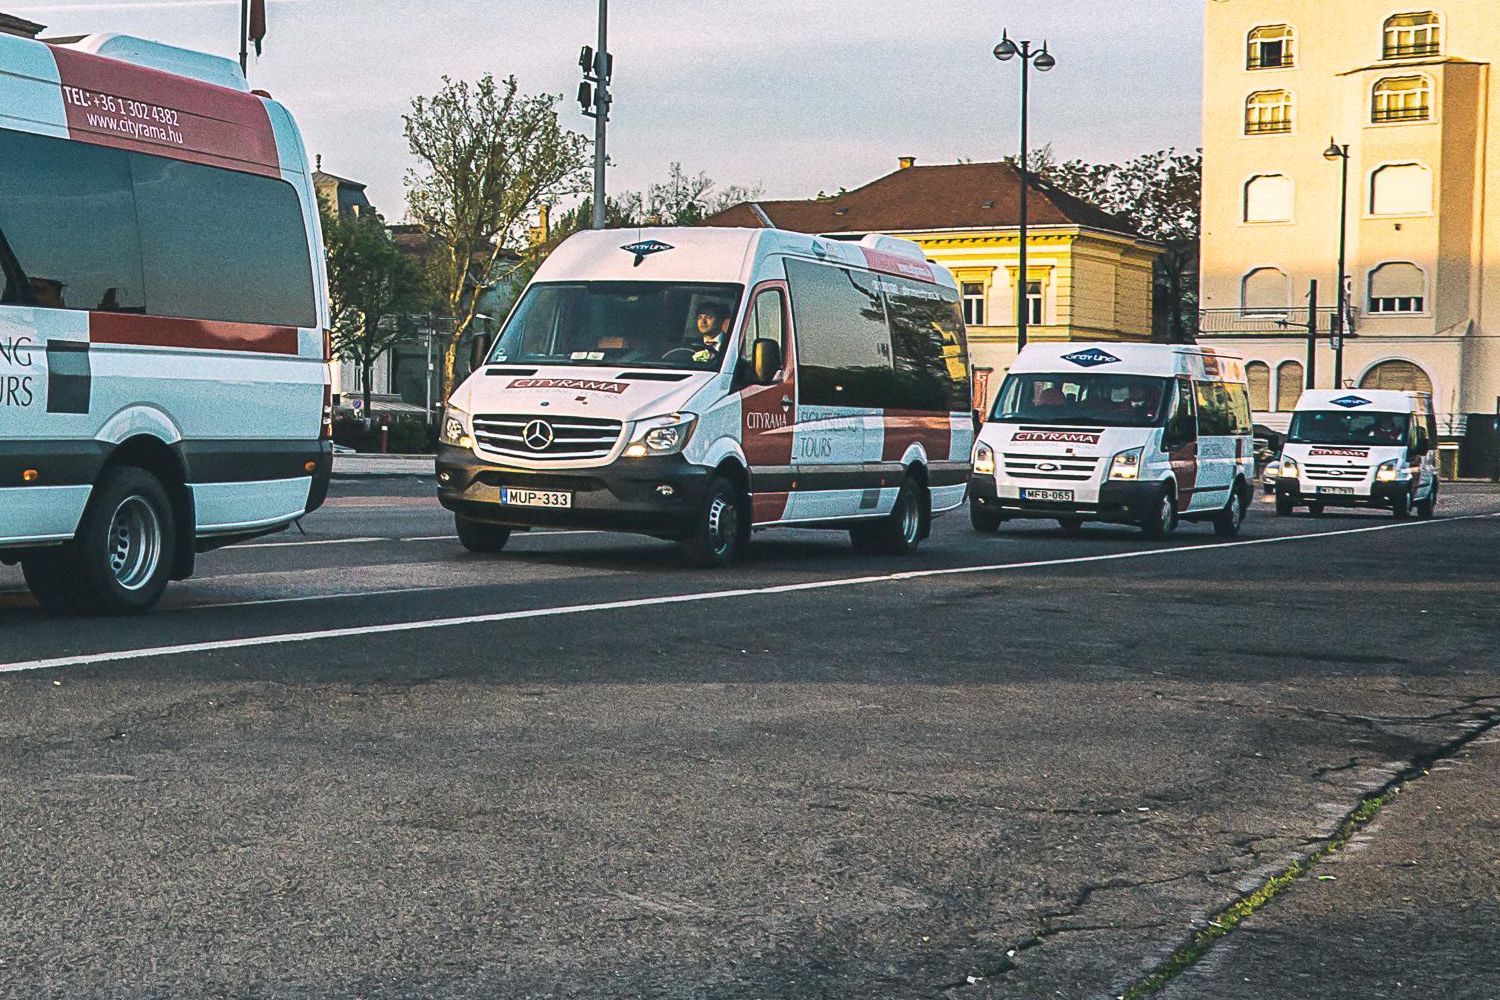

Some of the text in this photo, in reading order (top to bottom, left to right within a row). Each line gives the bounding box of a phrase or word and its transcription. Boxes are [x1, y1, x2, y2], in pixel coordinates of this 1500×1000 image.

[63, 86, 180, 127] TEL: +36 1 302 4382
[86, 113, 183, 144] www.cityrama.hu
[513, 379, 619, 392] CITYRAMA
[746, 412, 787, 429] CITYRAMA
[1015, 432, 1094, 443] CITYRAMA
[800, 437, 832, 458] TOURS
[509, 491, 568, 506] MUP-333
